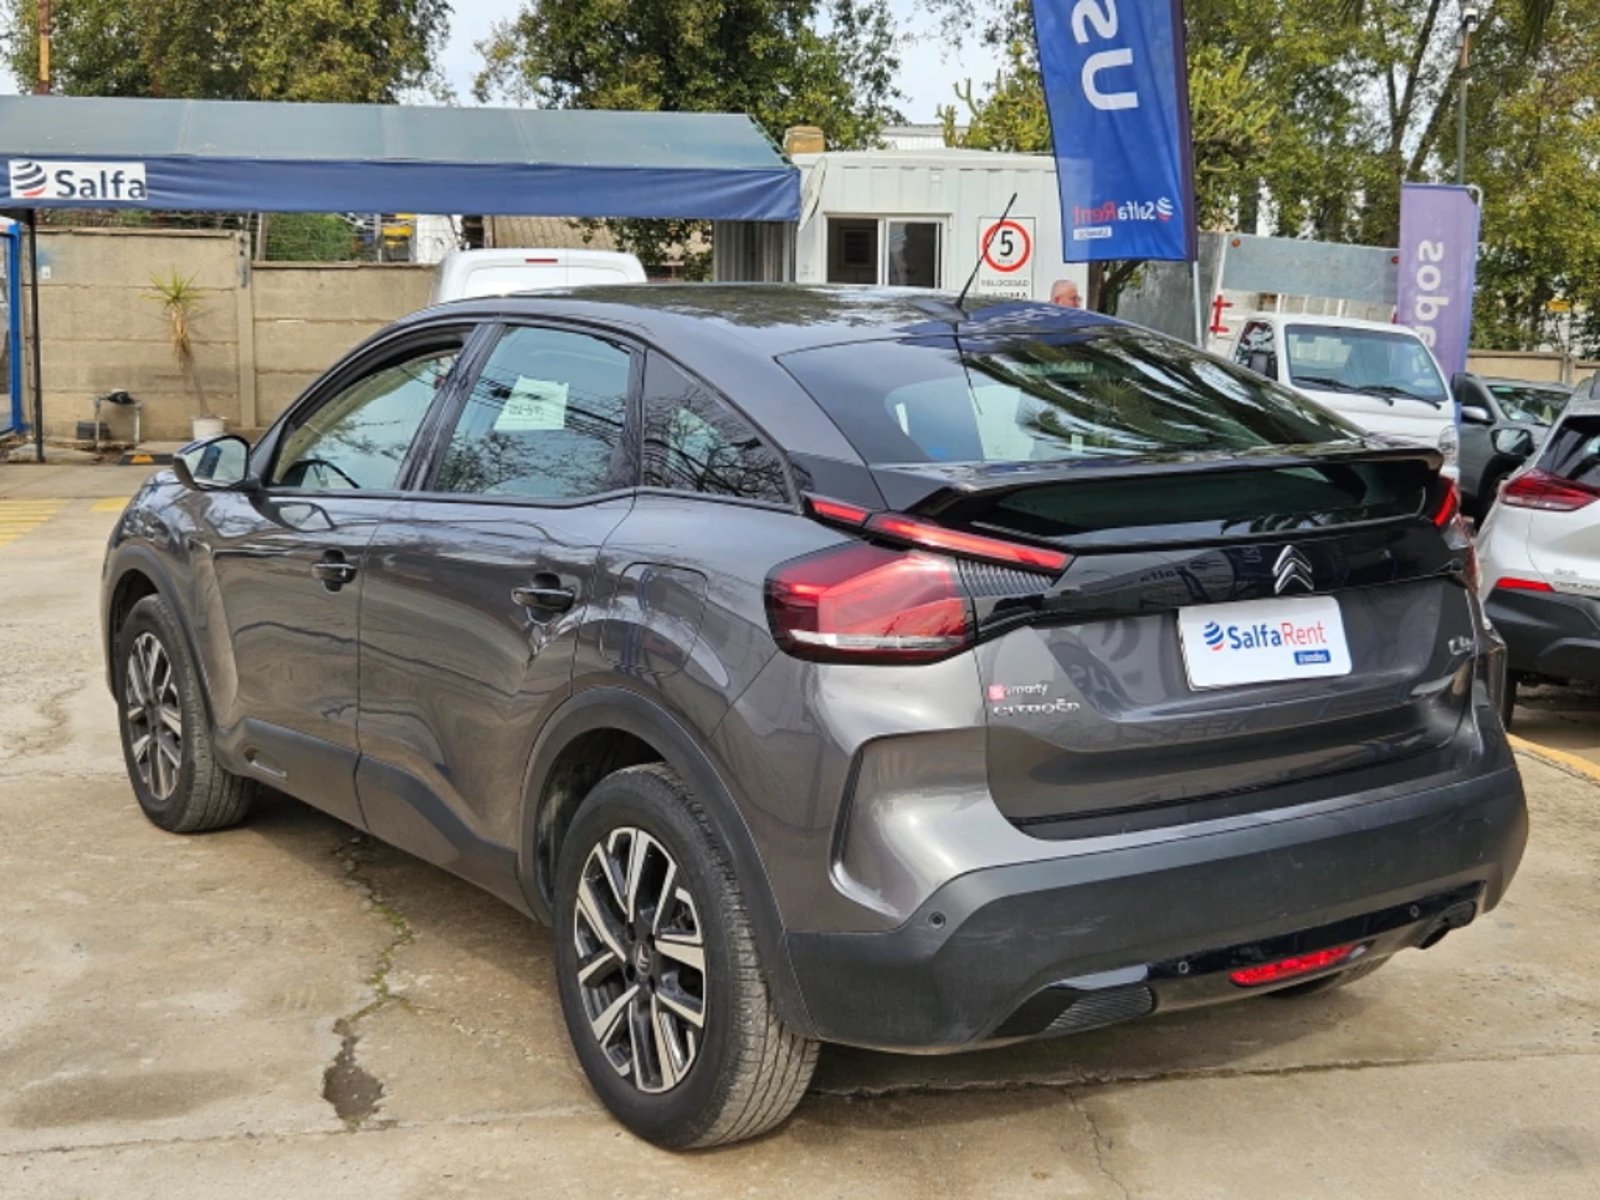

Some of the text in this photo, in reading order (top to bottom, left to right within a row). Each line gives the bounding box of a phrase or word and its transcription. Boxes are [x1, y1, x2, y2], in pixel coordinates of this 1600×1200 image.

[55, 169, 146, 198] Salfa
[1000, 230, 1014, 257] 5
[1227, 621, 1327, 650] SalfaRent
